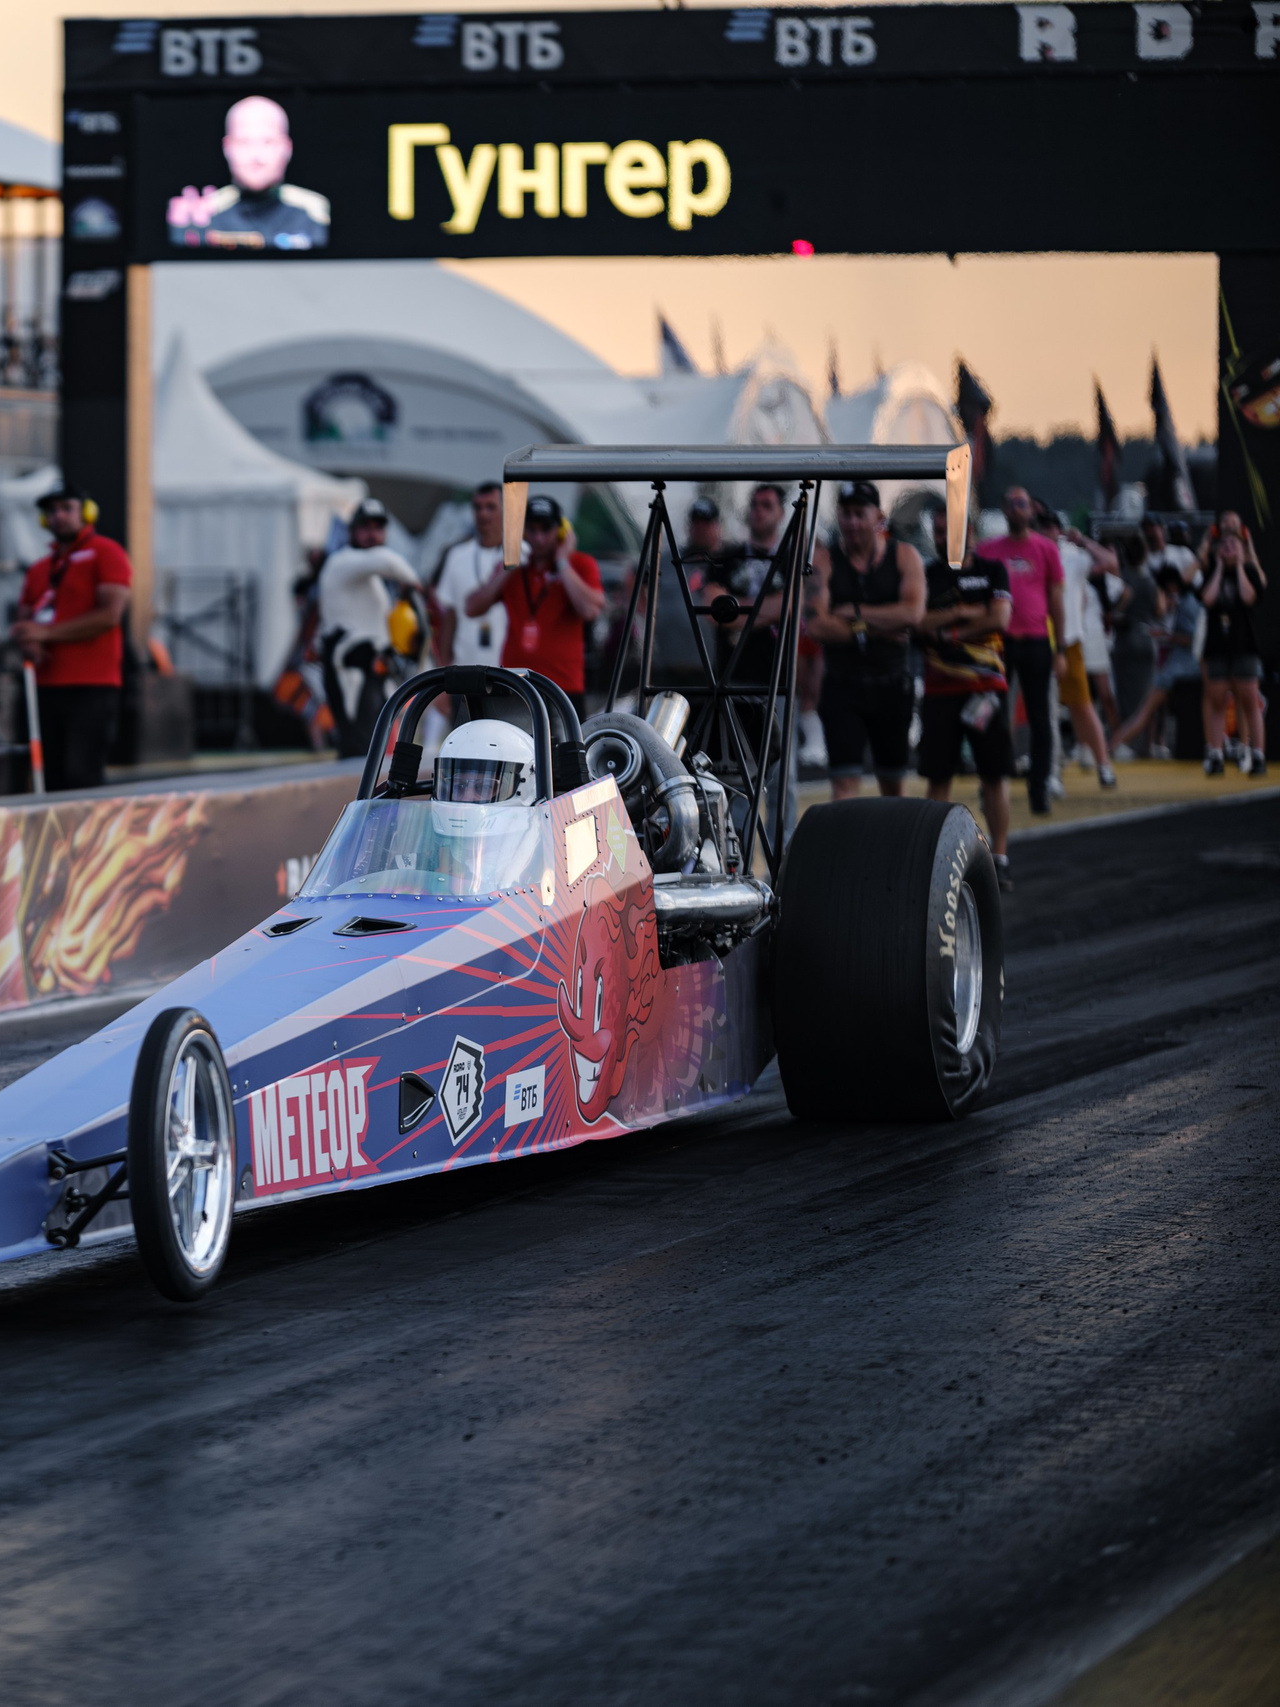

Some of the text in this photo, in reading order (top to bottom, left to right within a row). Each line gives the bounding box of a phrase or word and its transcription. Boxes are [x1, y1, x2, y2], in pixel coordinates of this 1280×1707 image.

[160, 27, 262, 76] ВТБ
[461, 21, 564, 71] ВТБ
[775, 16, 877, 67] ВТБ
[388, 122, 732, 235] Гунгер
[455, 1073, 470, 1106] 74
[520, 1084, 538, 1112] ВТБ
